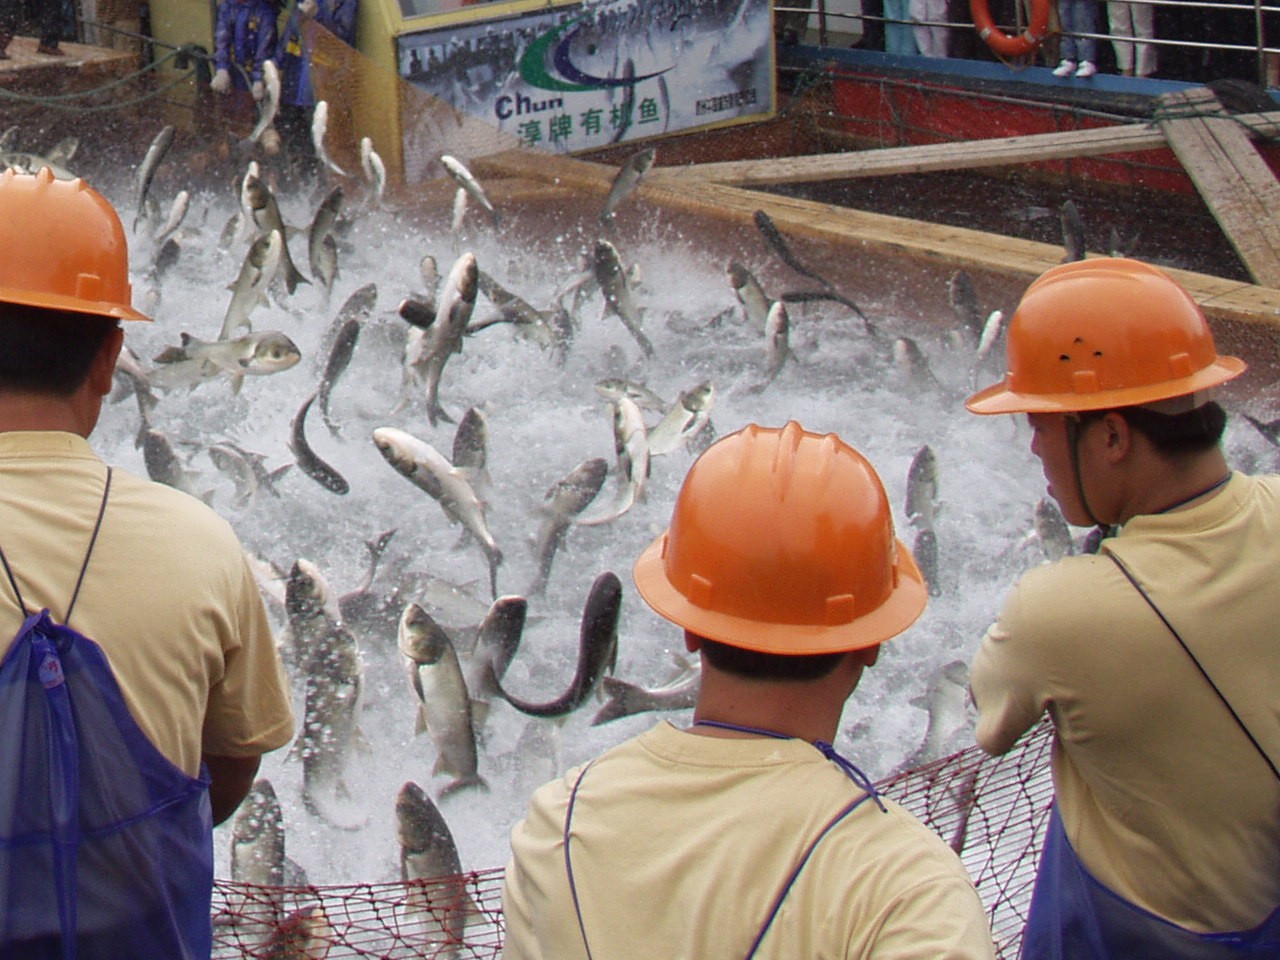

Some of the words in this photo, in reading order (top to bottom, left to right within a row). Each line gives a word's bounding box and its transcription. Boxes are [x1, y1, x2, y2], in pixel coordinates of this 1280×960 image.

[494, 91, 564, 120] Chun
[516, 97, 660, 148] 淳牌有机鱼
